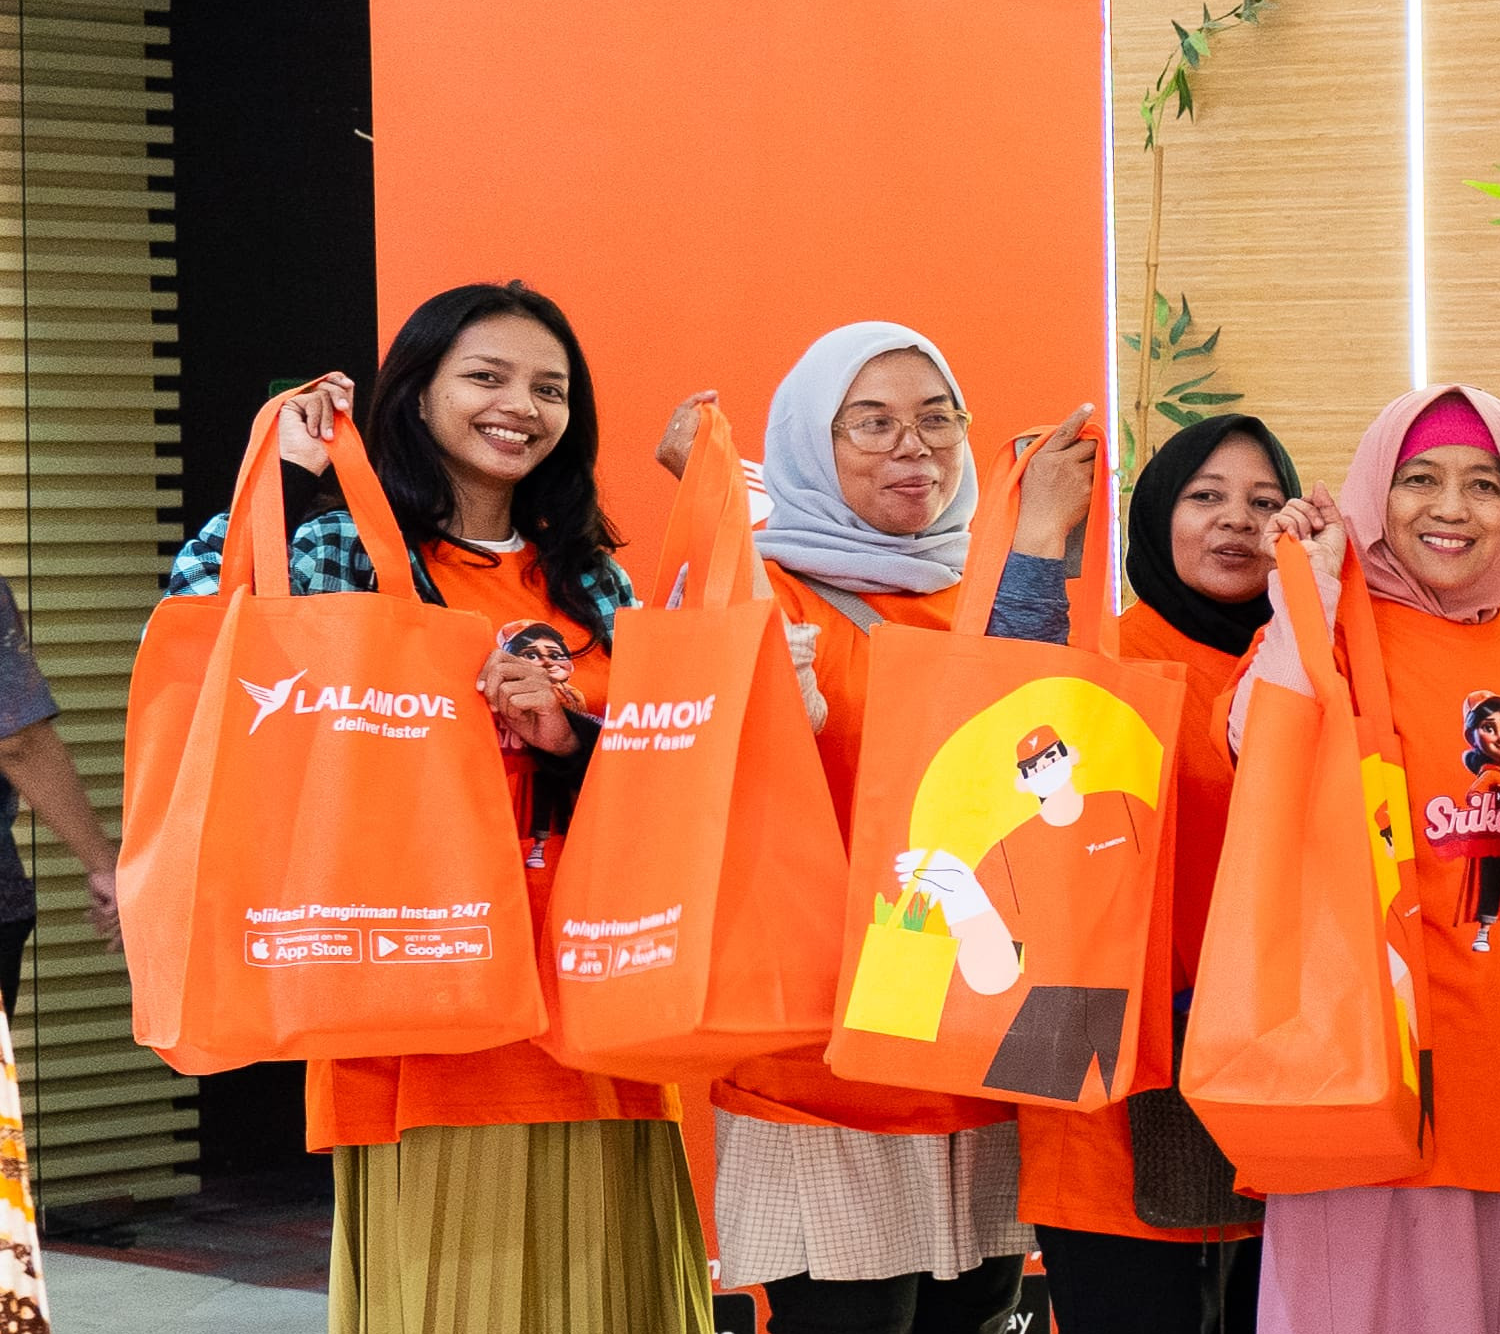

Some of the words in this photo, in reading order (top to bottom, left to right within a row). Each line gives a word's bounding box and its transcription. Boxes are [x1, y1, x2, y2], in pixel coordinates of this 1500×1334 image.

[295, 686, 456, 720] LALAMOVE
[604, 694, 716, 730] LAMOVE
[334, 716, 379, 734] deliver
[383, 723, 429, 738] faster
[246, 906, 305, 924] Aplikasi
[308, 904, 397, 921] Pengiriman
[401, 906, 448, 919] Instan
[451, 903, 490, 917] 24/7
[276, 944, 307, 960] App
[312, 942, 352, 956] Store
[405, 943, 453, 957] Google
[455, 942, 483, 955] Play
